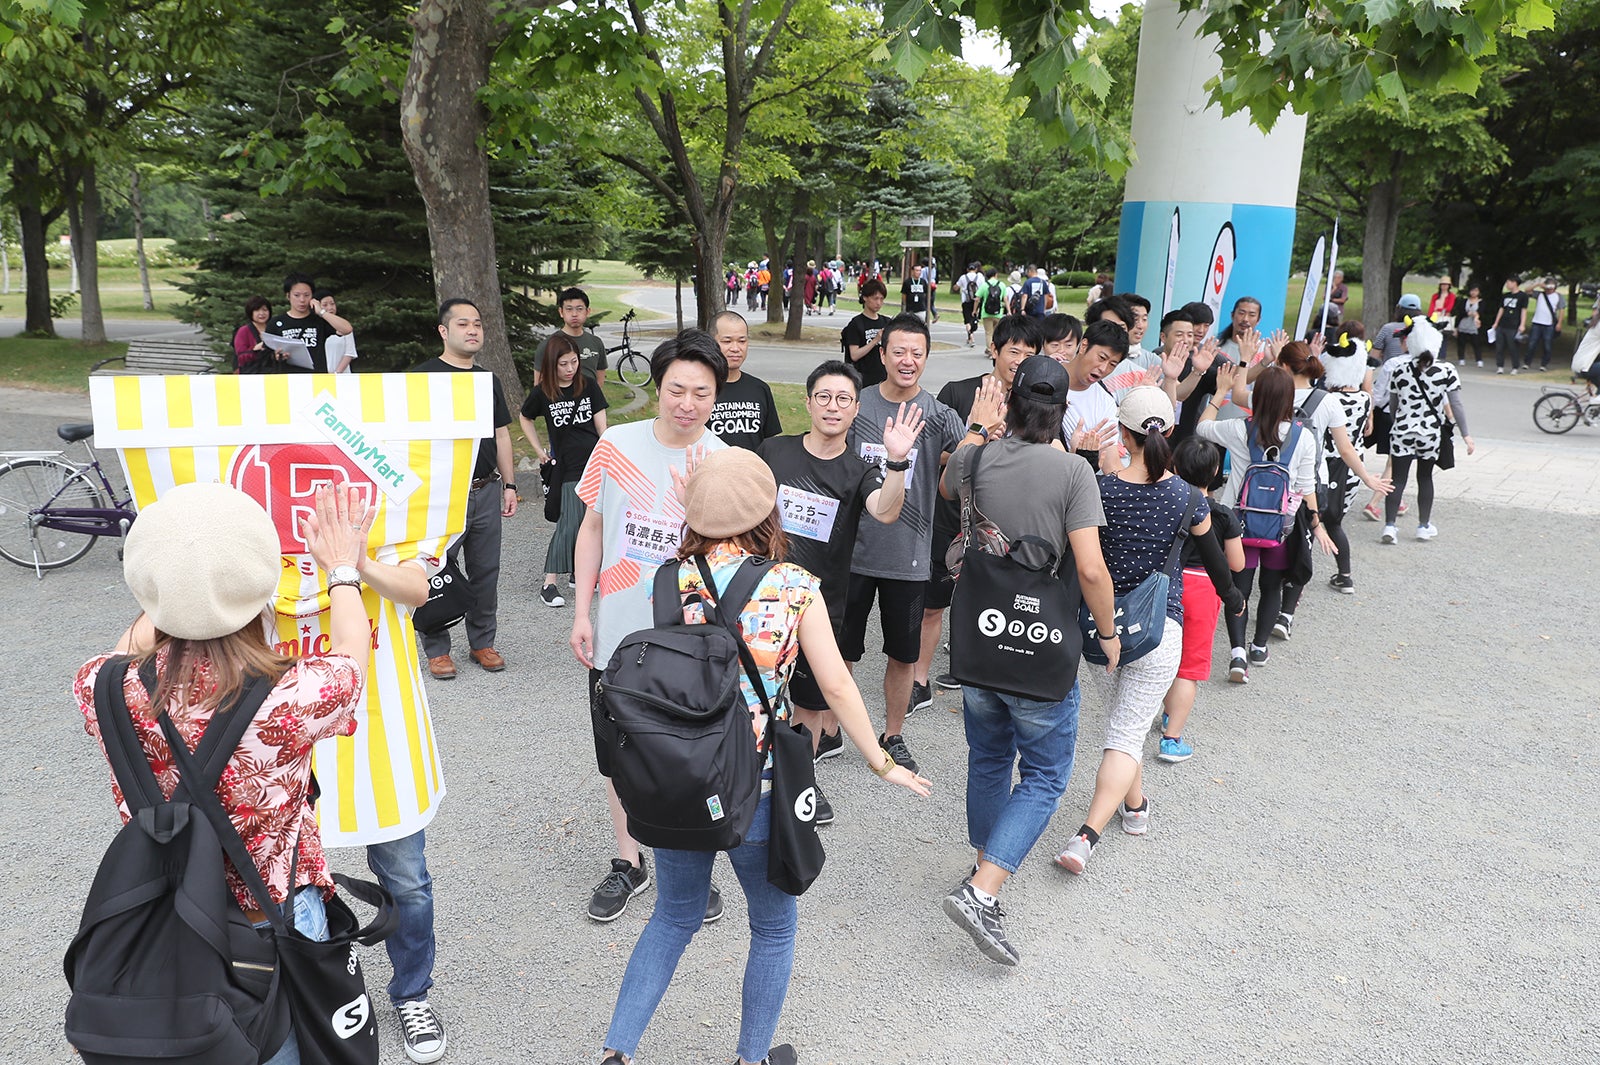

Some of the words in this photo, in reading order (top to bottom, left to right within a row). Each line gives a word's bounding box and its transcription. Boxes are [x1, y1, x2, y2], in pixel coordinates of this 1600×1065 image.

[712, 401, 760, 411] USTAINABLE
[710, 410, 760, 421] DEVELOPMENT
[711, 418, 760, 435] GOALS
[315, 402, 405, 488] FamilyMart
[783, 498, 828, 517] すっちー
[633, 513, 651, 523] SDGs
[652, 518, 668, 527] walk
[669, 521, 681, 529] 201
[625, 522, 679, 547] 信濃岳夫
[1013, 602, 1040, 614] GOALS
